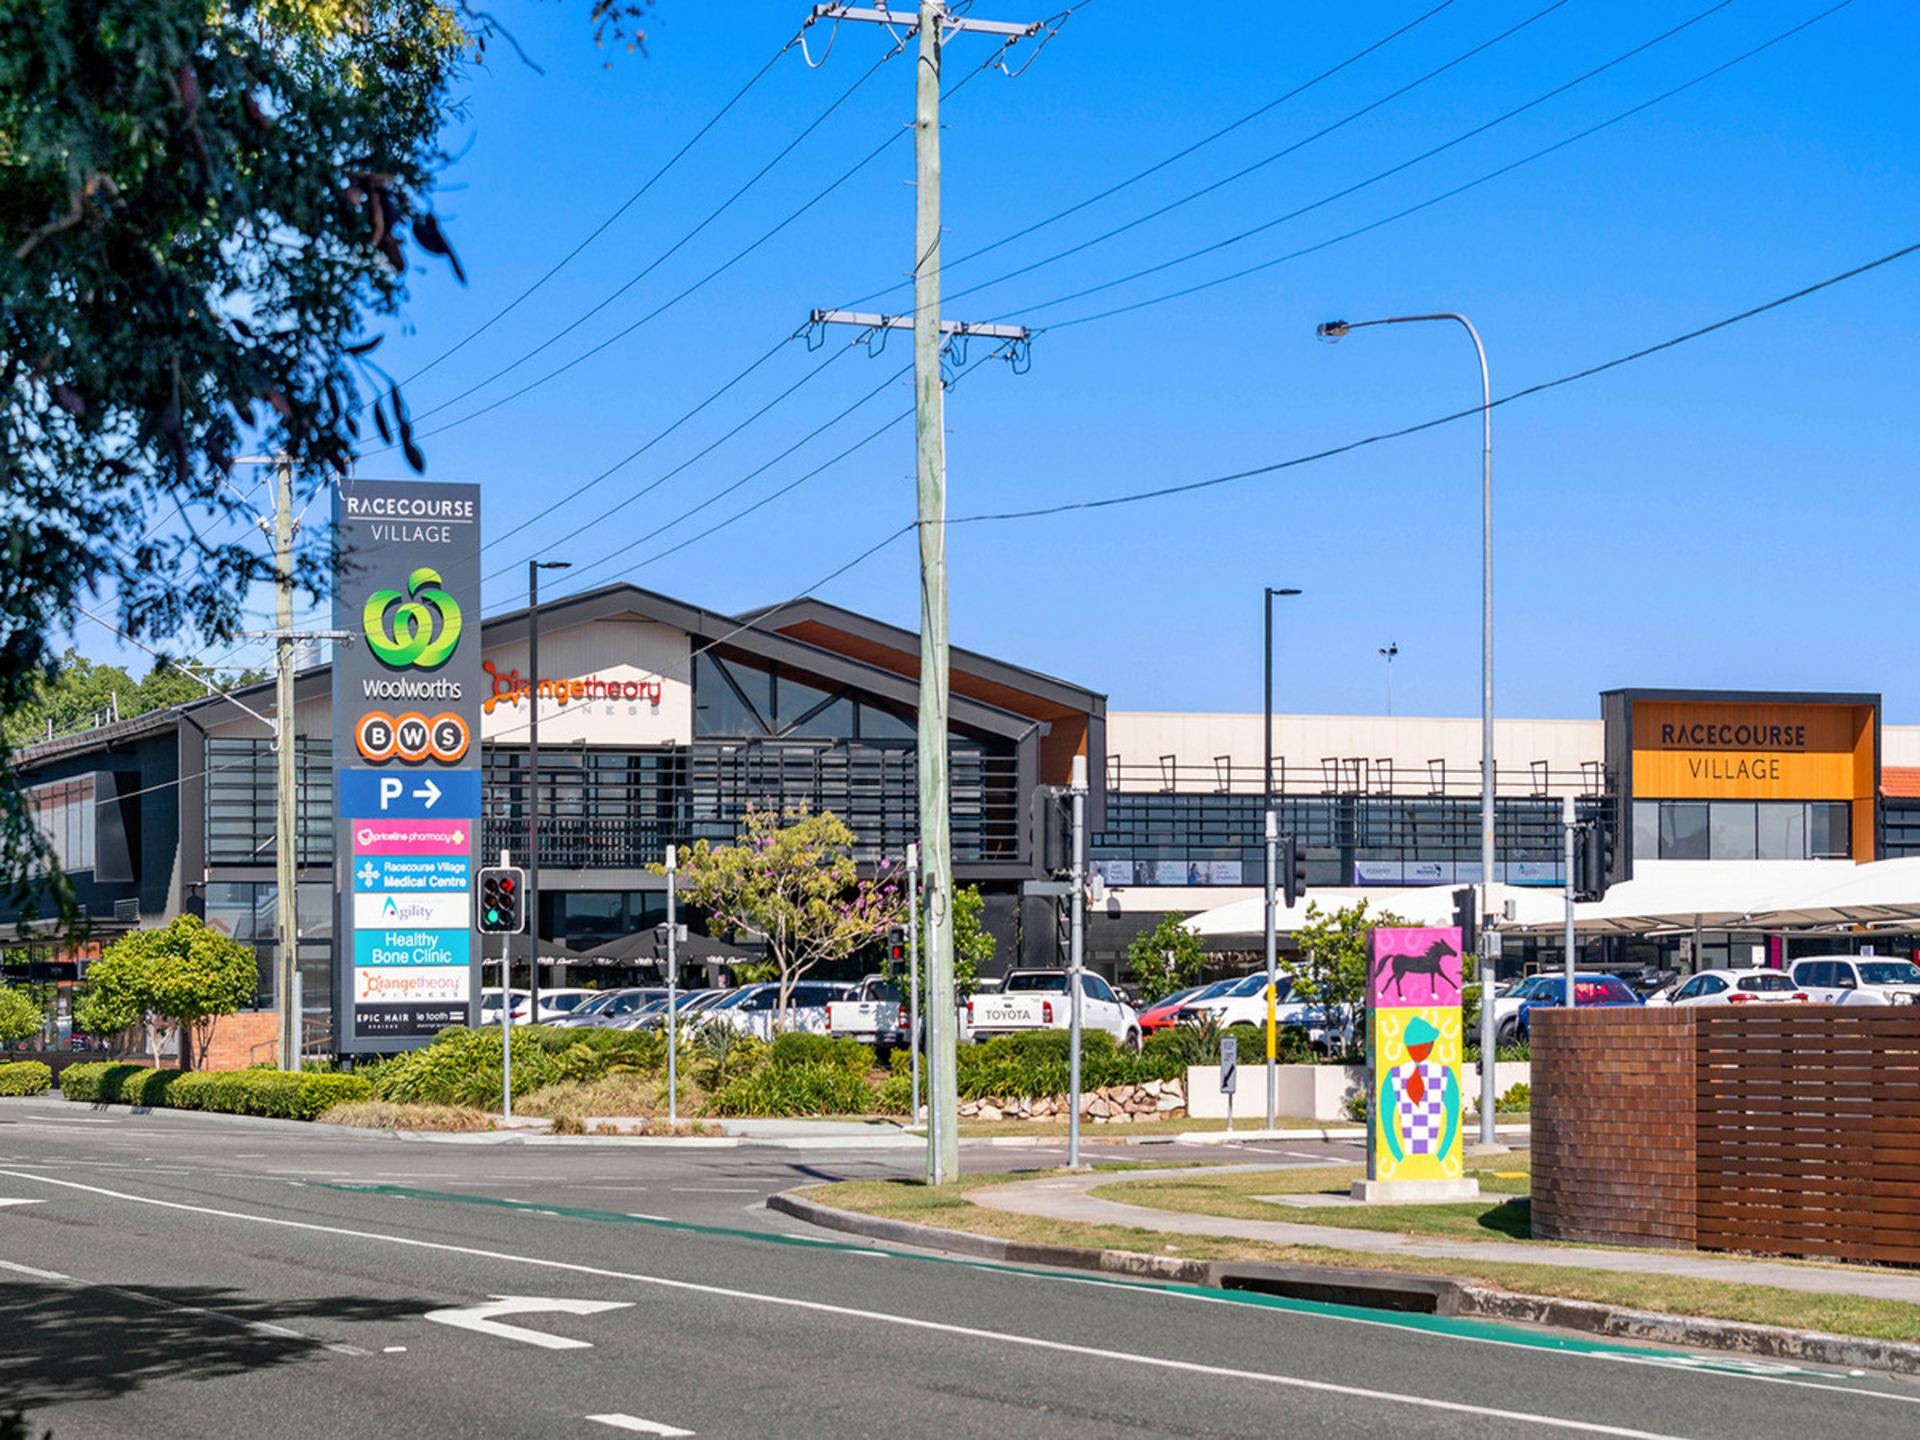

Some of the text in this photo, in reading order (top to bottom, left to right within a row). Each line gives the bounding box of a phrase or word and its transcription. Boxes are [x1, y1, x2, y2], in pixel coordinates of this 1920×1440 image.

[348, 497, 473, 517] RACECOURSE
[371, 524, 451, 543] VILLAGE
[362, 677, 462, 699] Woolworths
[372, 727, 454, 746] BWS
[1662, 724, 1805, 746] RACECOURSE
[1688, 758, 1780, 780] VILLAGE
[380, 777, 403, 810] P
[373, 831, 451, 844] priceline pharmacy
[384, 861, 466, 874] Racecourse Village
[384, 875, 466, 887] Medical Centre
[382, 895, 433, 920] Agility
[385, 932, 439, 950] Healthy
[372, 948, 452, 964] Bone Clinic
[356, 1013, 409, 1023] EPIC HAIR
[985, 1009, 1032, 1020] TOYOTA
